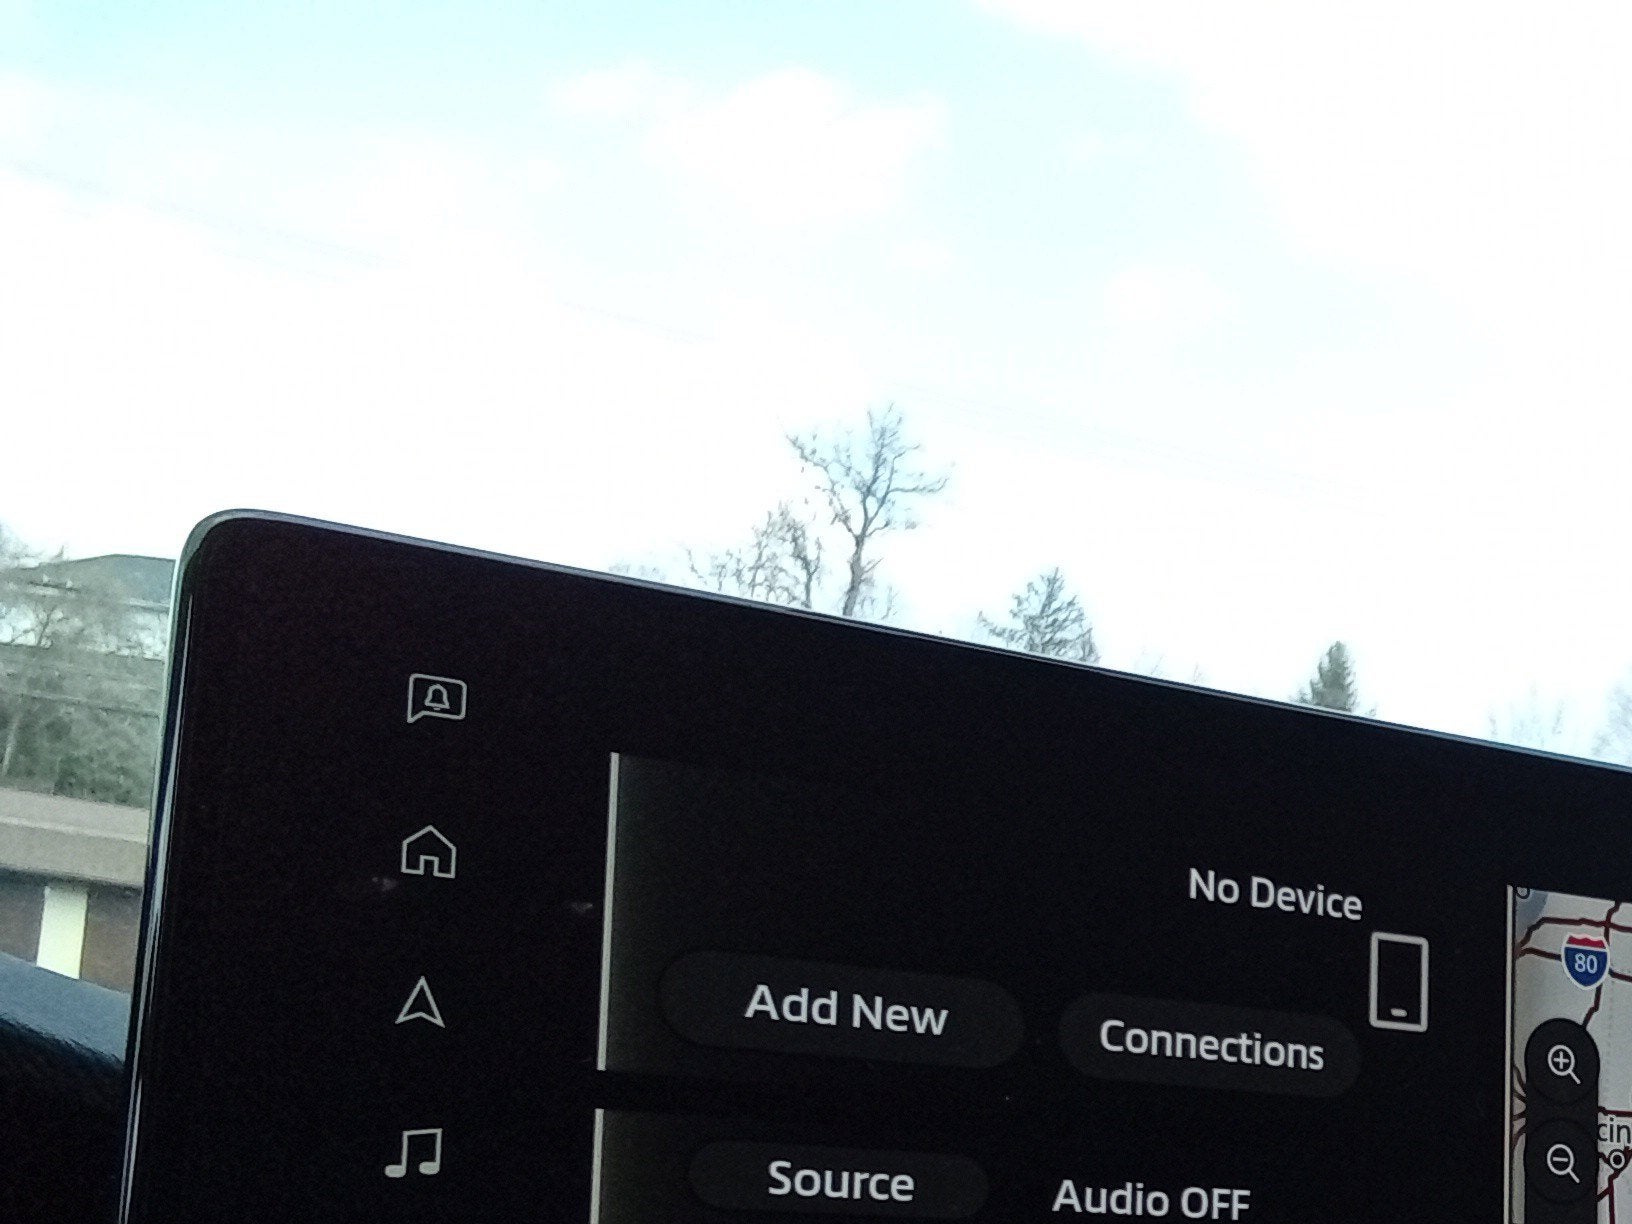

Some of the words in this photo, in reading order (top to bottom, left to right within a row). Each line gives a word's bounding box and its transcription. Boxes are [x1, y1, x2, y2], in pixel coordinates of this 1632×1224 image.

[1189, 867, 1240, 904] No
[1250, 875, 1363, 921] Device
[1574, 952, 1598, 974] 80
[743, 984, 838, 1026] Add
[851, 993, 950, 1036] New
[1099, 1019, 1324, 1071] Connections
[768, 1160, 915, 1202] Source
[1051, 1179, 1170, 1217] Audio
[1180, 1186, 1251, 1221] OFF
